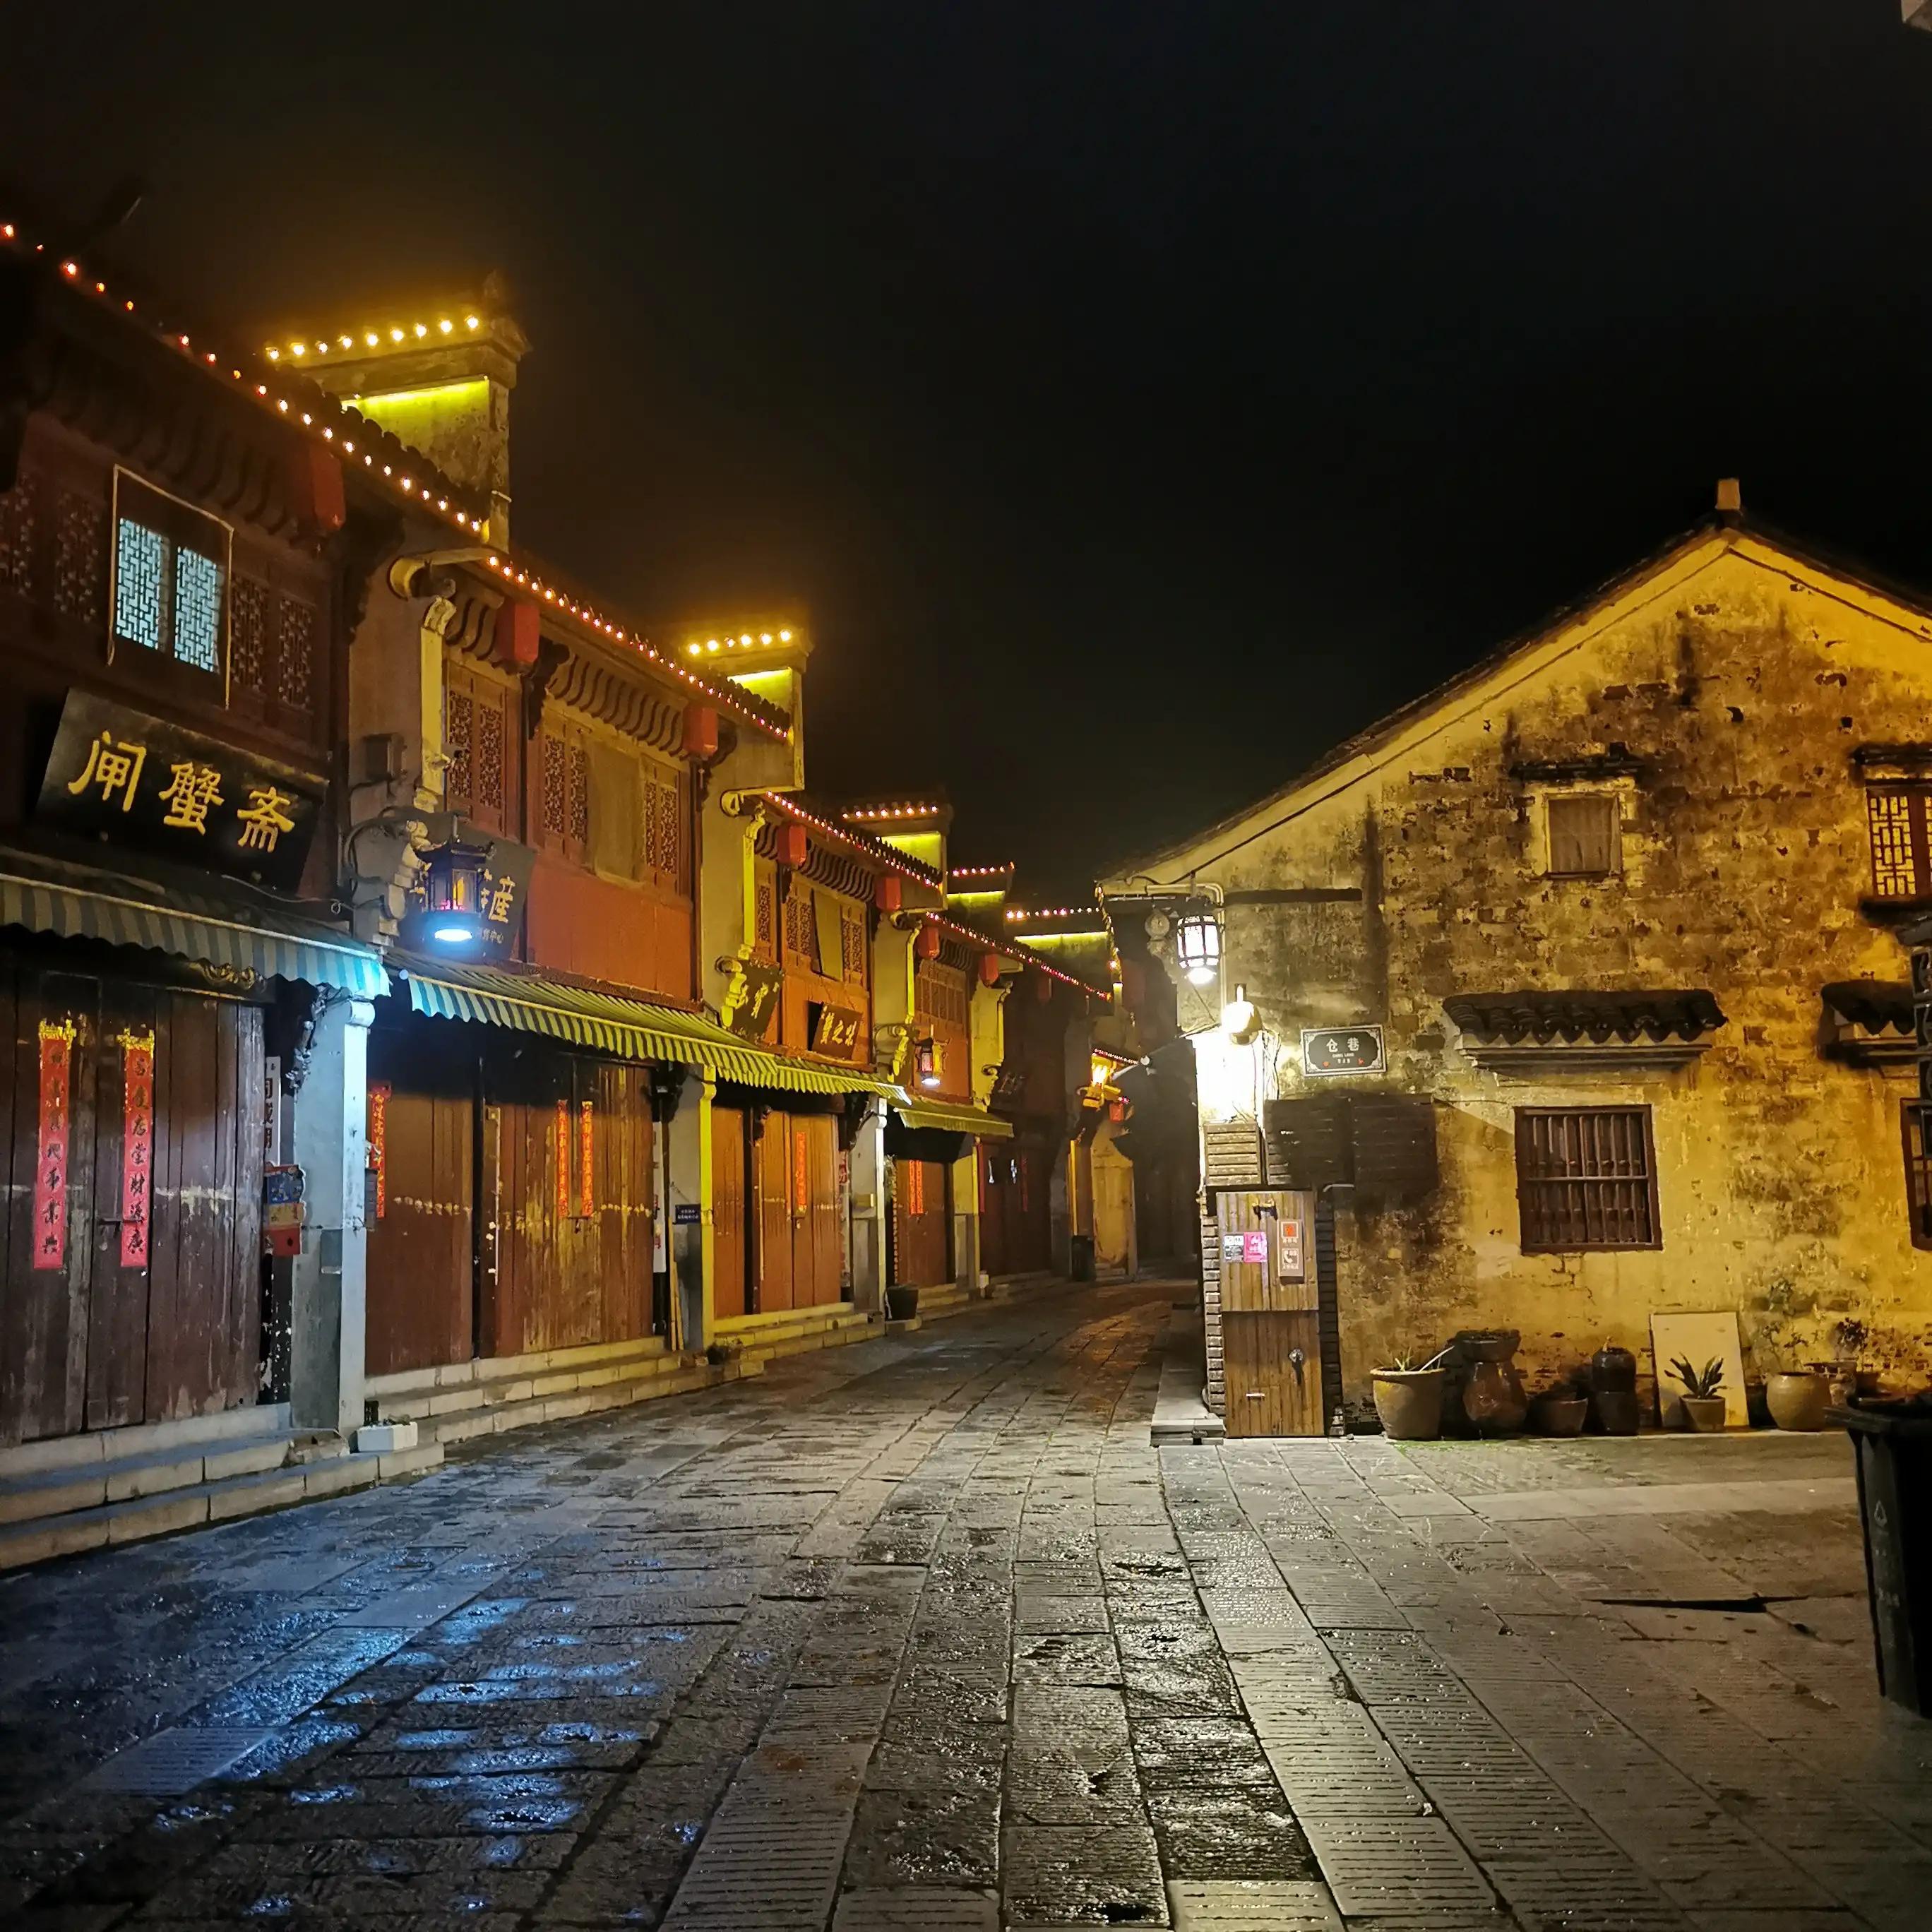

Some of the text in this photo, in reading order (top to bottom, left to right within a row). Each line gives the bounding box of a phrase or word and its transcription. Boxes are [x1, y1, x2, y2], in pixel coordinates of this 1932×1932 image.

[68, 730, 295, 853] 闸蟹斋
[1326, 1037, 1359, 1052] 仓巷
